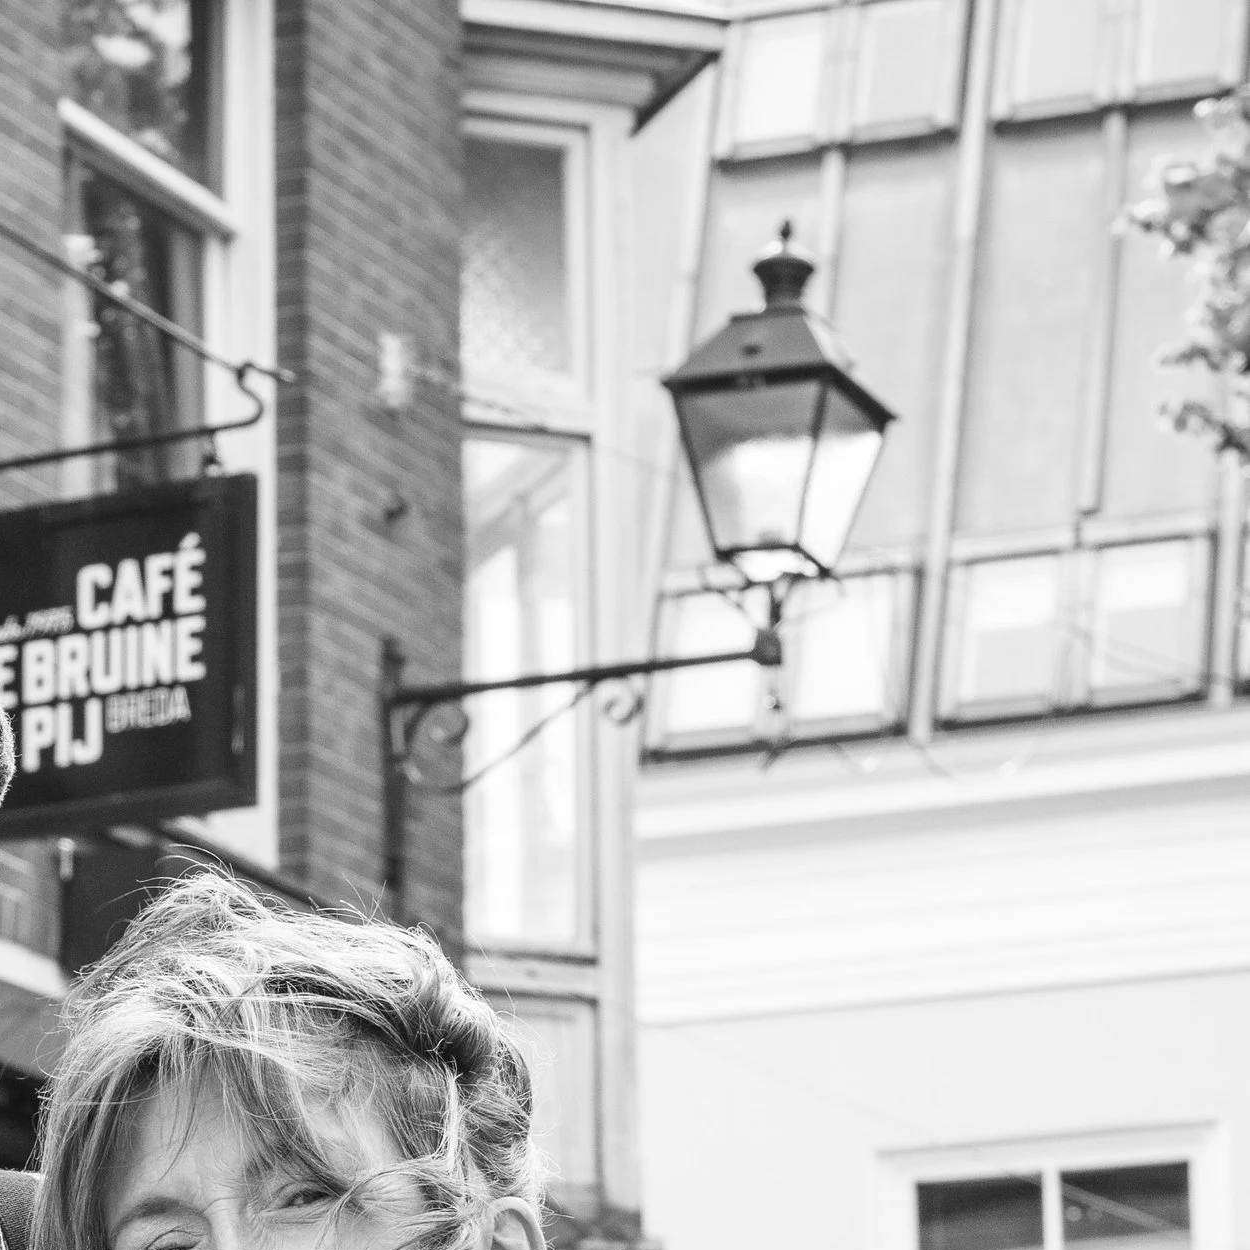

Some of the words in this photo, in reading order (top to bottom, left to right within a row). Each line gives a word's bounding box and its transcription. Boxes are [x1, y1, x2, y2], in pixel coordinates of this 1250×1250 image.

[76, 532, 206, 629] CAFÉ
[21, 614, 206, 705] BRUINE
[21, 697, 103, 773] PIJ
[104, 686, 192, 733] BREDA
